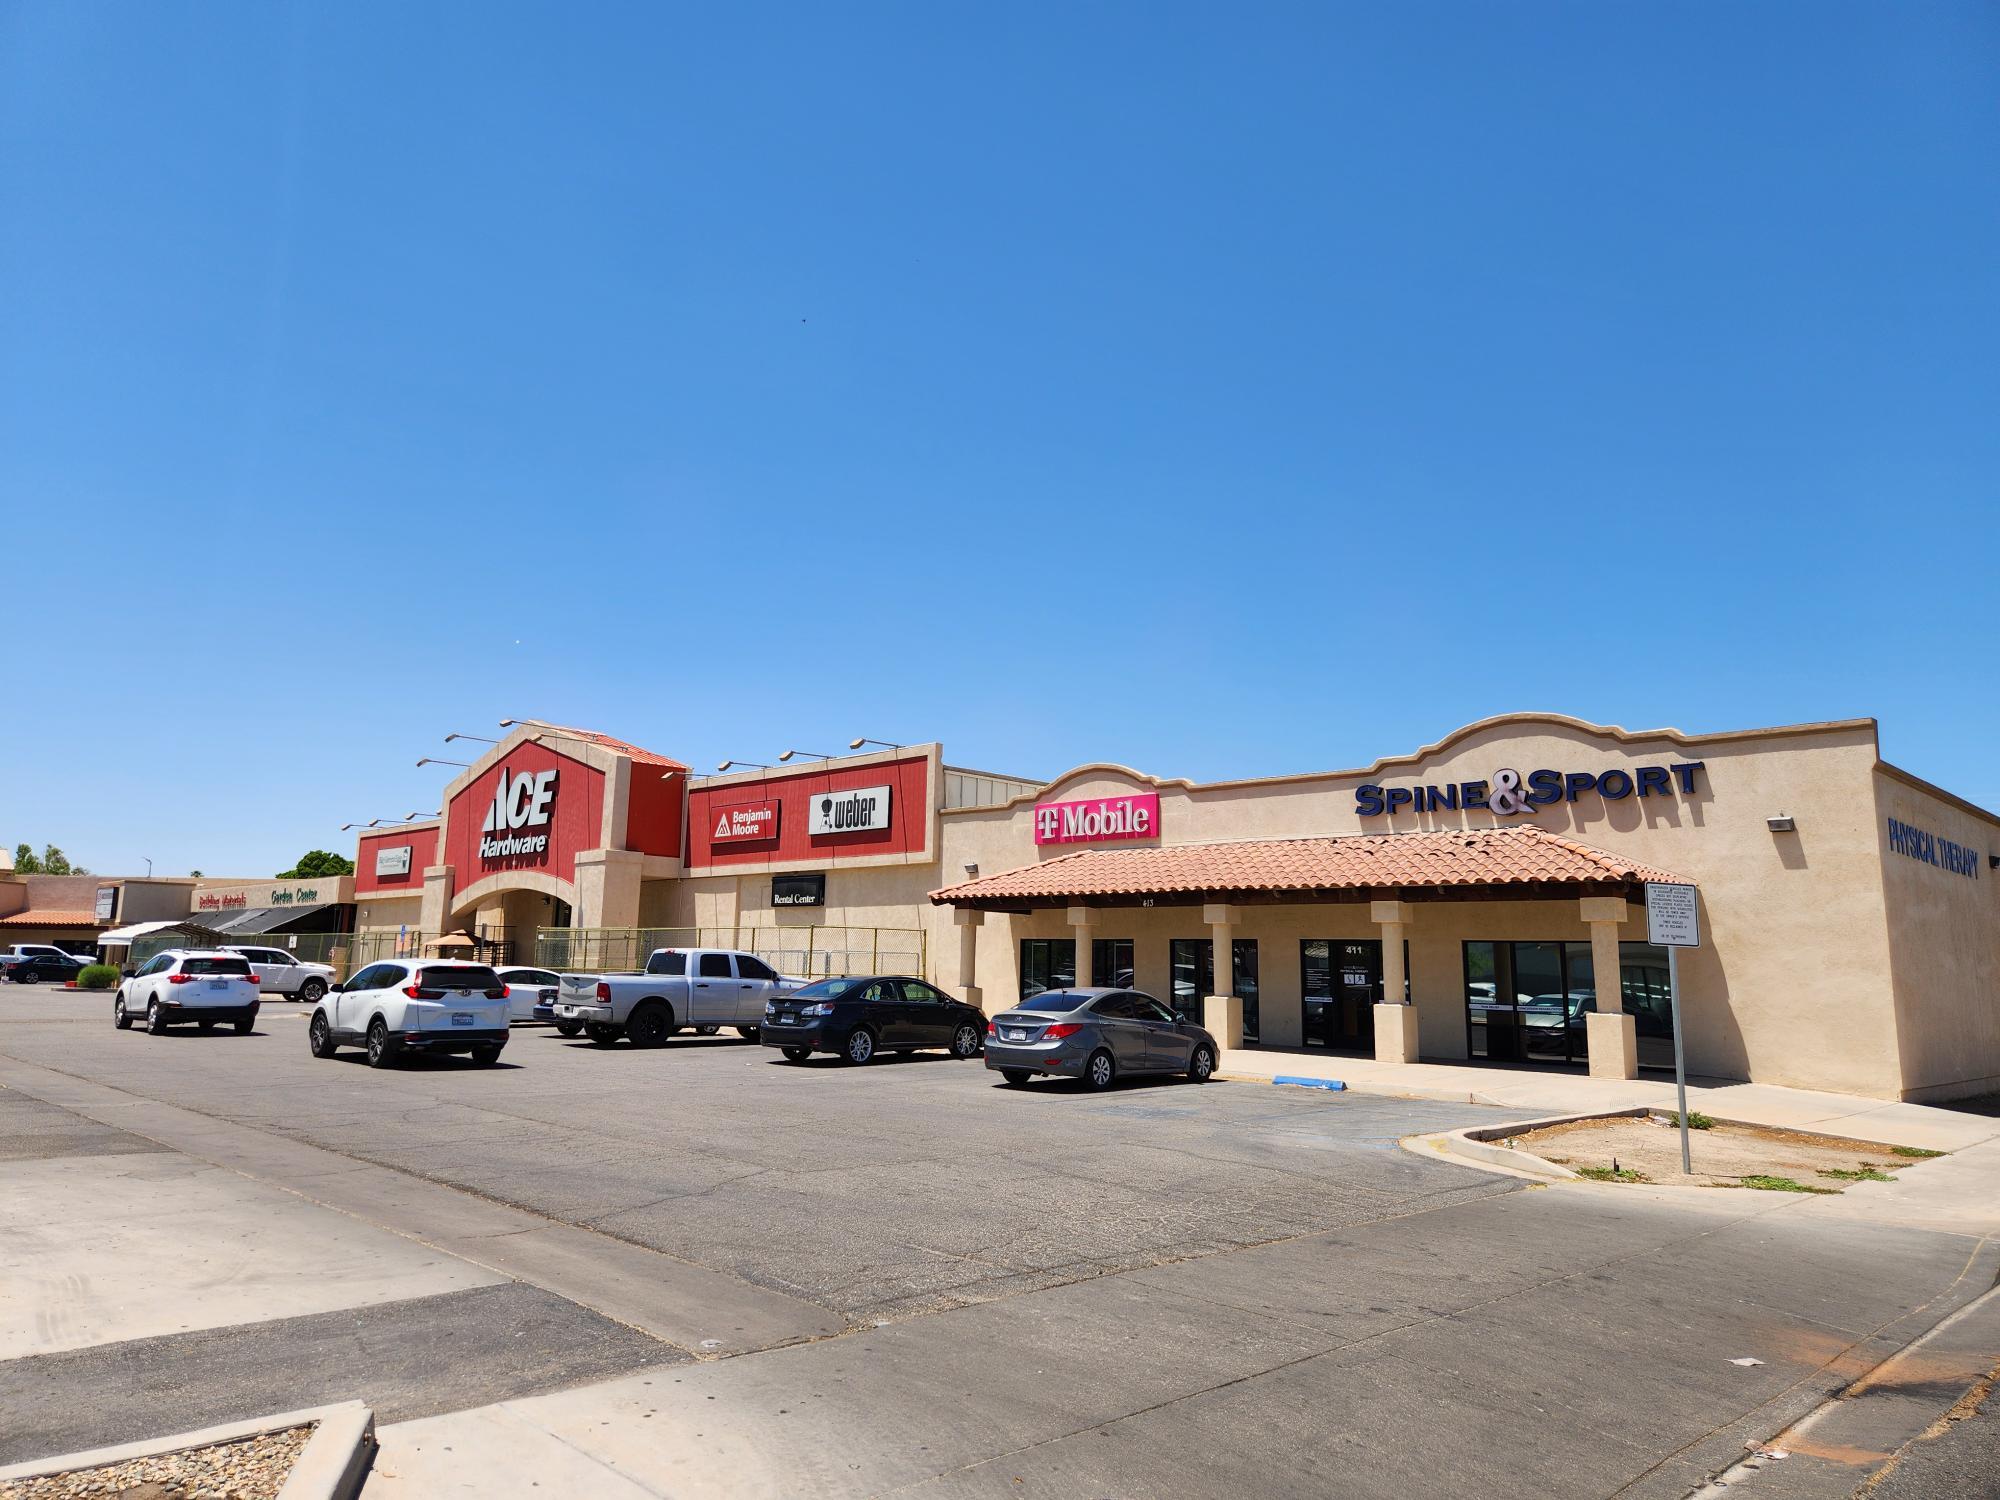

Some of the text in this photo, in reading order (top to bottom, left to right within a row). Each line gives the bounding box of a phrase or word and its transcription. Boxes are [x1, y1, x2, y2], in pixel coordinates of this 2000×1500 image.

[1355, 780, 1489, 816] SPINE
[1527, 761, 1705, 805] SPORT
[481, 767, 557, 832] ACE
[732, 808, 771, 824] Benjamin
[834, 793, 876, 829] weber
[732, 823, 759, 836] Moore
[478, 834, 547, 859] Hardware
[1888, 817, 1978, 880] PHYSICAL THERAPY
[271, 887, 318, 902] Garden Center
[774, 893, 816, 904] Rental Center
[1142, 899, 1154, 907] 413
[1345, 945, 1362, 954] 411
